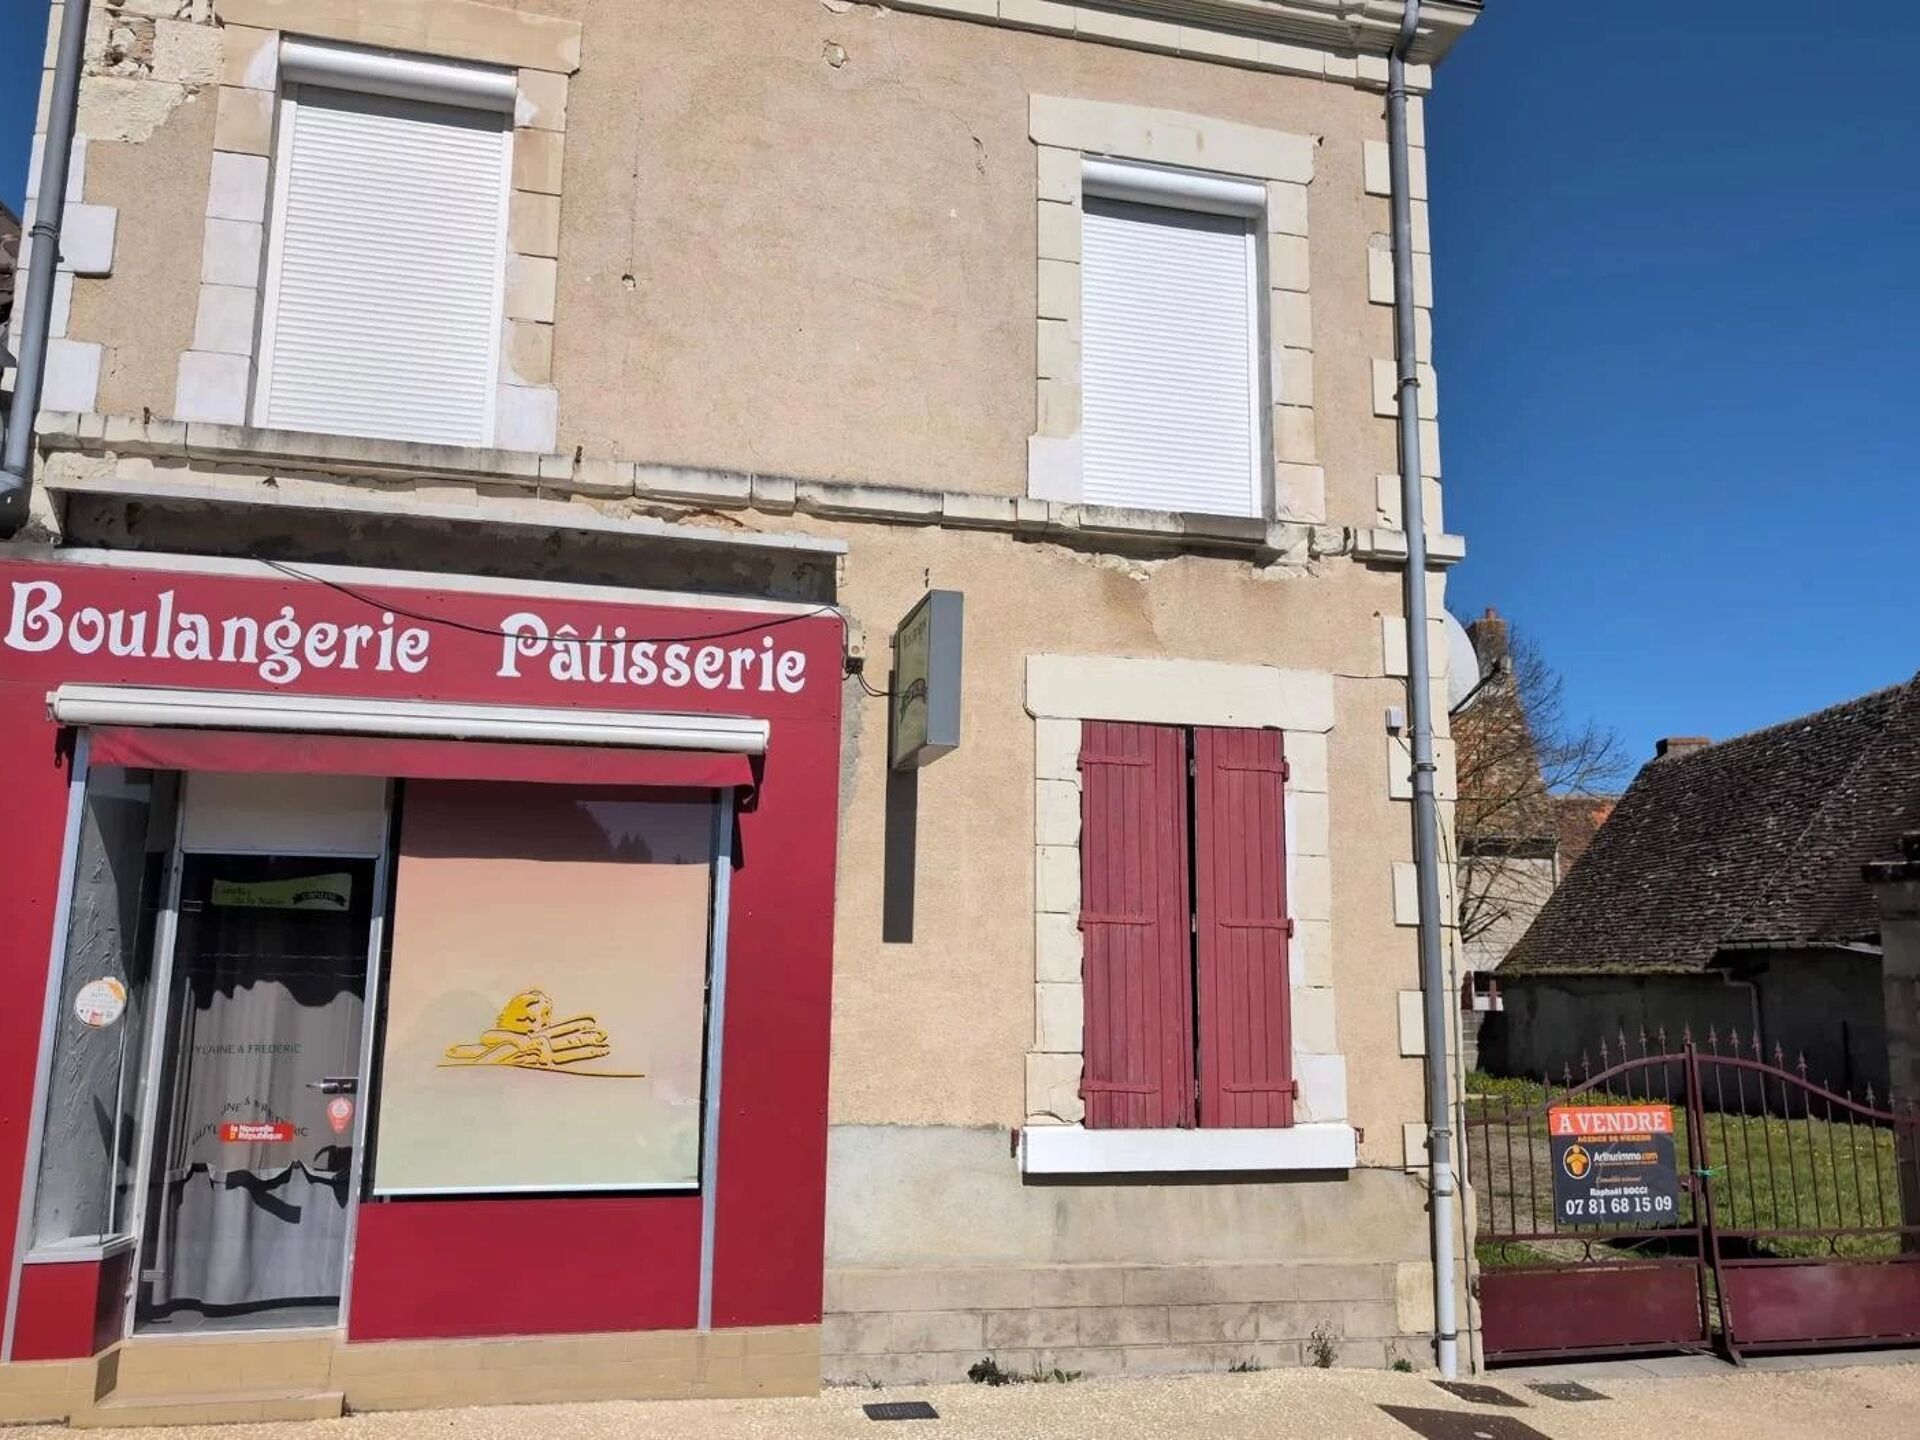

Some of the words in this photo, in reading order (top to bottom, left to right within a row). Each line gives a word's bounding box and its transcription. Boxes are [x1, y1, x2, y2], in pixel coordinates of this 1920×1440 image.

[4, 581, 430, 684] Boulangerie
[496, 612, 806, 694] Pâtisserie
[1559, 1115, 1574, 1133] A
[1576, 1111, 1667, 1133] VENDRE
[1566, 1199, 1584, 1215] 07
[1588, 1198, 1606, 1214] 81
[1611, 1197, 1630, 1213] 68
[1635, 1196, 1651, 1212] 15
[1654, 1195, 1672, 1211] 09
